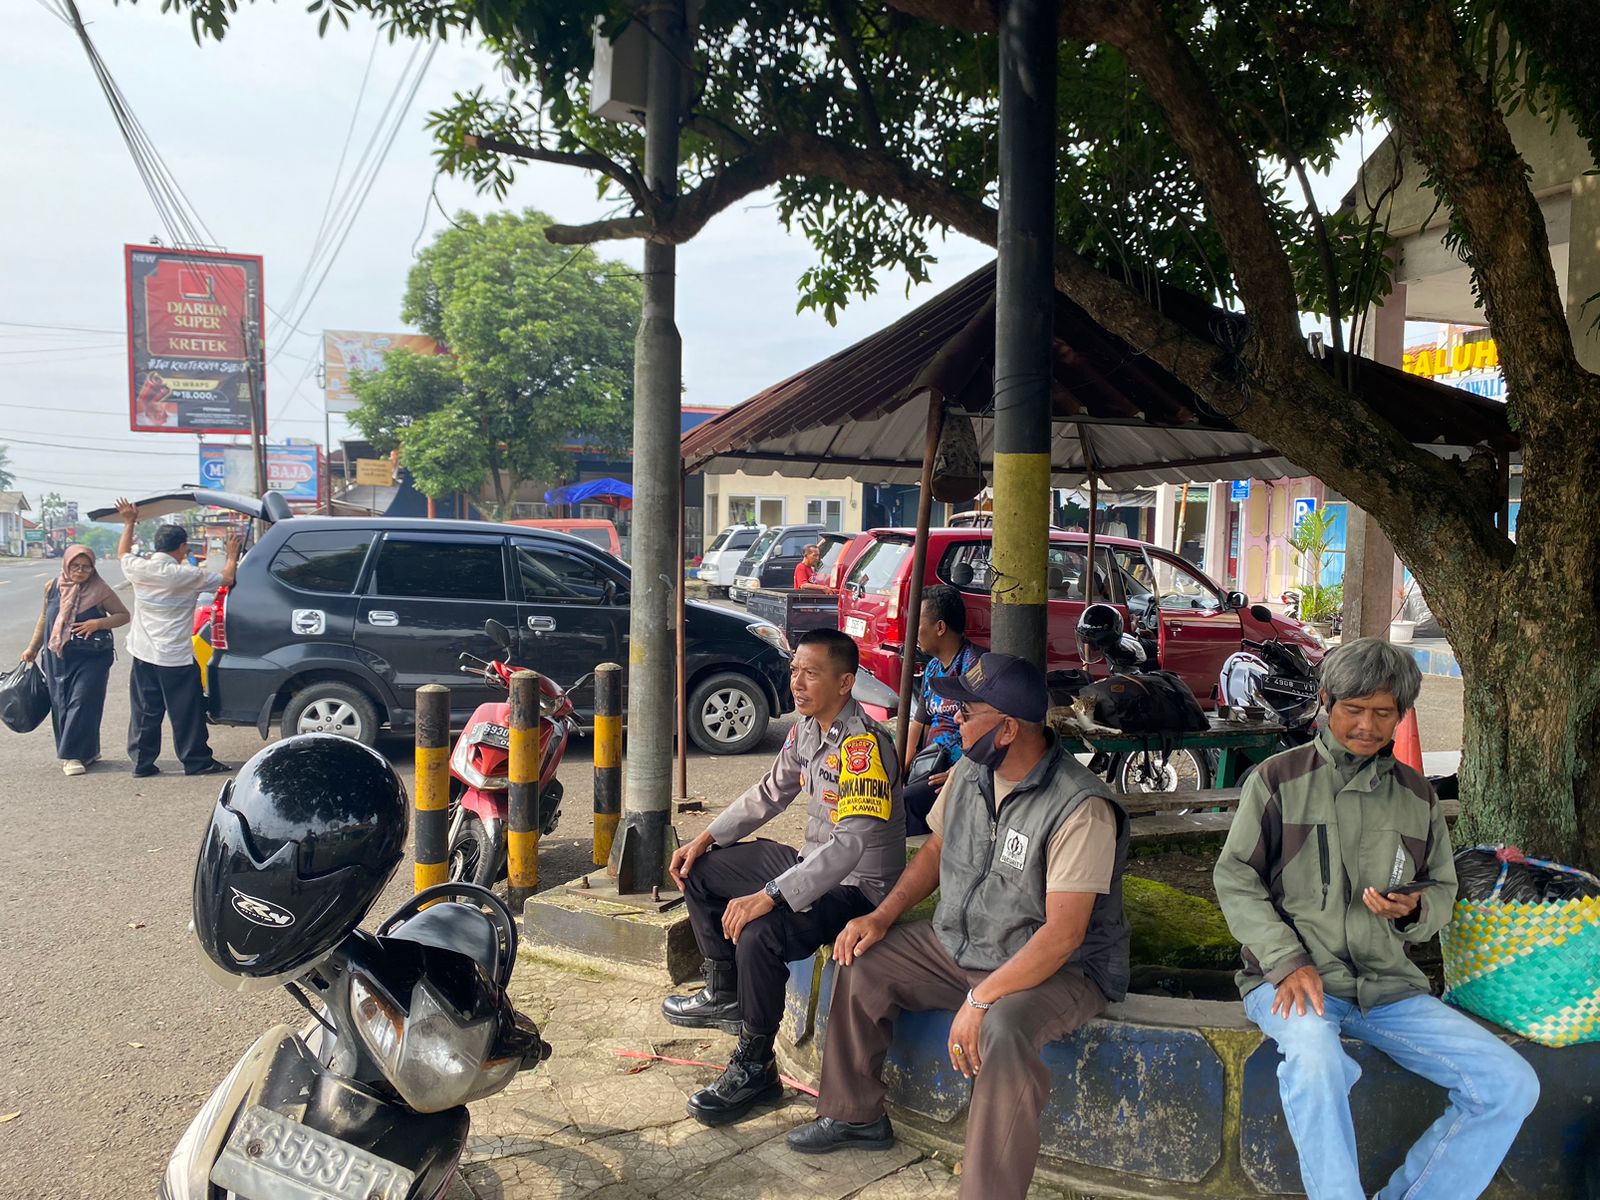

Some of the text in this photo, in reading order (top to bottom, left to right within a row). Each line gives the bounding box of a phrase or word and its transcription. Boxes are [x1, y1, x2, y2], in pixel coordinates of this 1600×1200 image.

[132, 254, 157, 263] NEW
[174, 315, 221, 329] SUPER
[168, 337, 228, 353] KRETEK
[270, 466, 308, 479] BAJA
